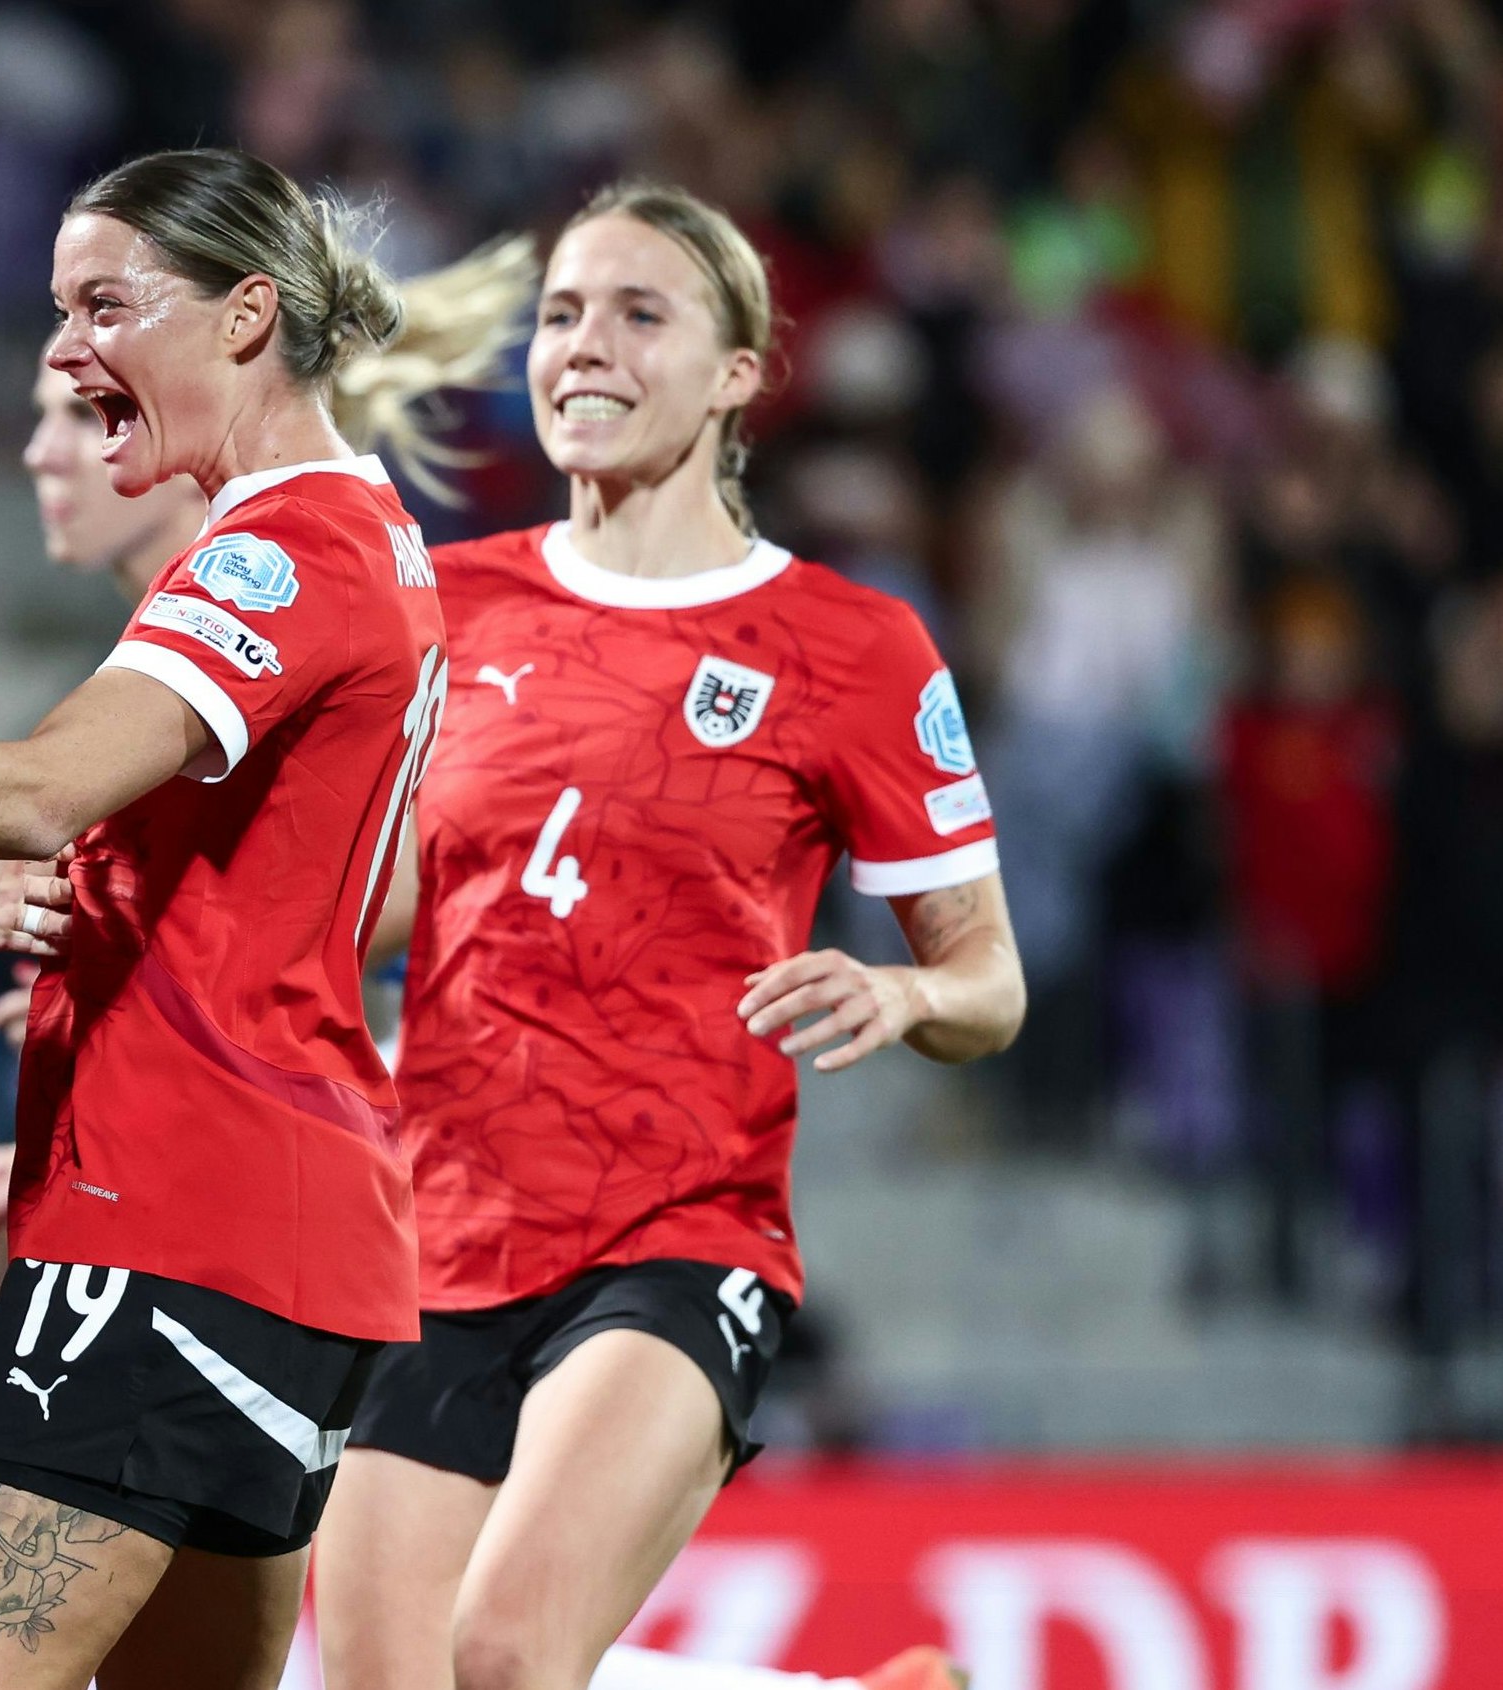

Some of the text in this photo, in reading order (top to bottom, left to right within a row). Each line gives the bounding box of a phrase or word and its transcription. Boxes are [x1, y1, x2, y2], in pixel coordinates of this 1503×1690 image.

[230, 552, 247, 563] We
[223, 566, 262, 589] Strong
[150, 604, 234, 641] FOUNDATION
[234, 633, 264, 666] 10
[520, 785, 589, 919] 4
[15, 1257, 131, 1362] 19
